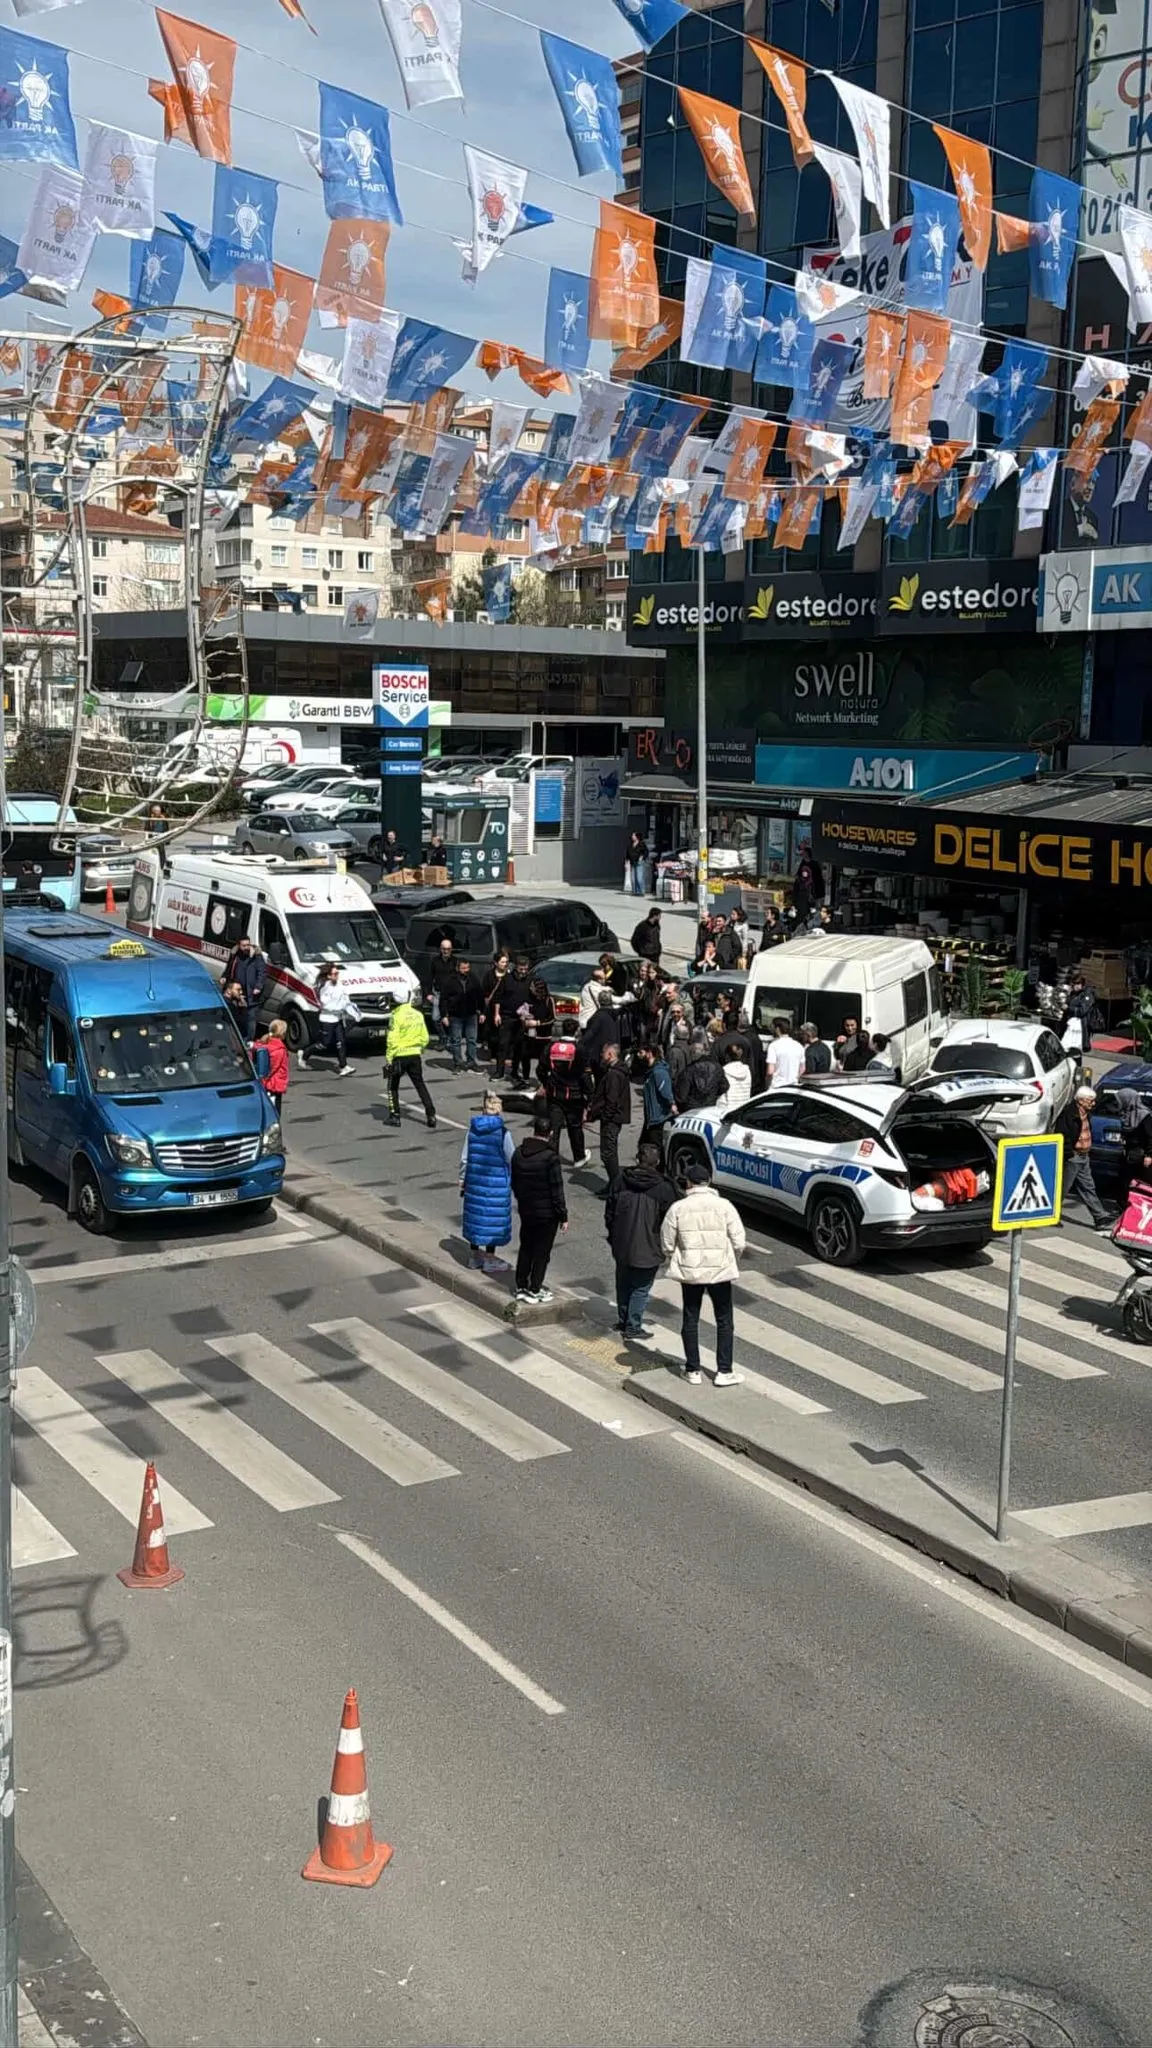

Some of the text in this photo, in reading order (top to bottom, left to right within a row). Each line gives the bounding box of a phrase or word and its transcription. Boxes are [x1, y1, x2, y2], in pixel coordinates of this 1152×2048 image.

[1101, 572, 1142, 604] AK
[794, 651, 874, 698] swell
[381, 675, 427, 690] BOSCH
[382, 690, 427, 703] Service
[302, 703, 341, 717] Garanti
[795, 711, 879, 726] Network Marketing
[821, 822, 918, 847] HOUSEWARES
[297, 892, 316, 902] 112
[175, 914, 189, 932] 112
